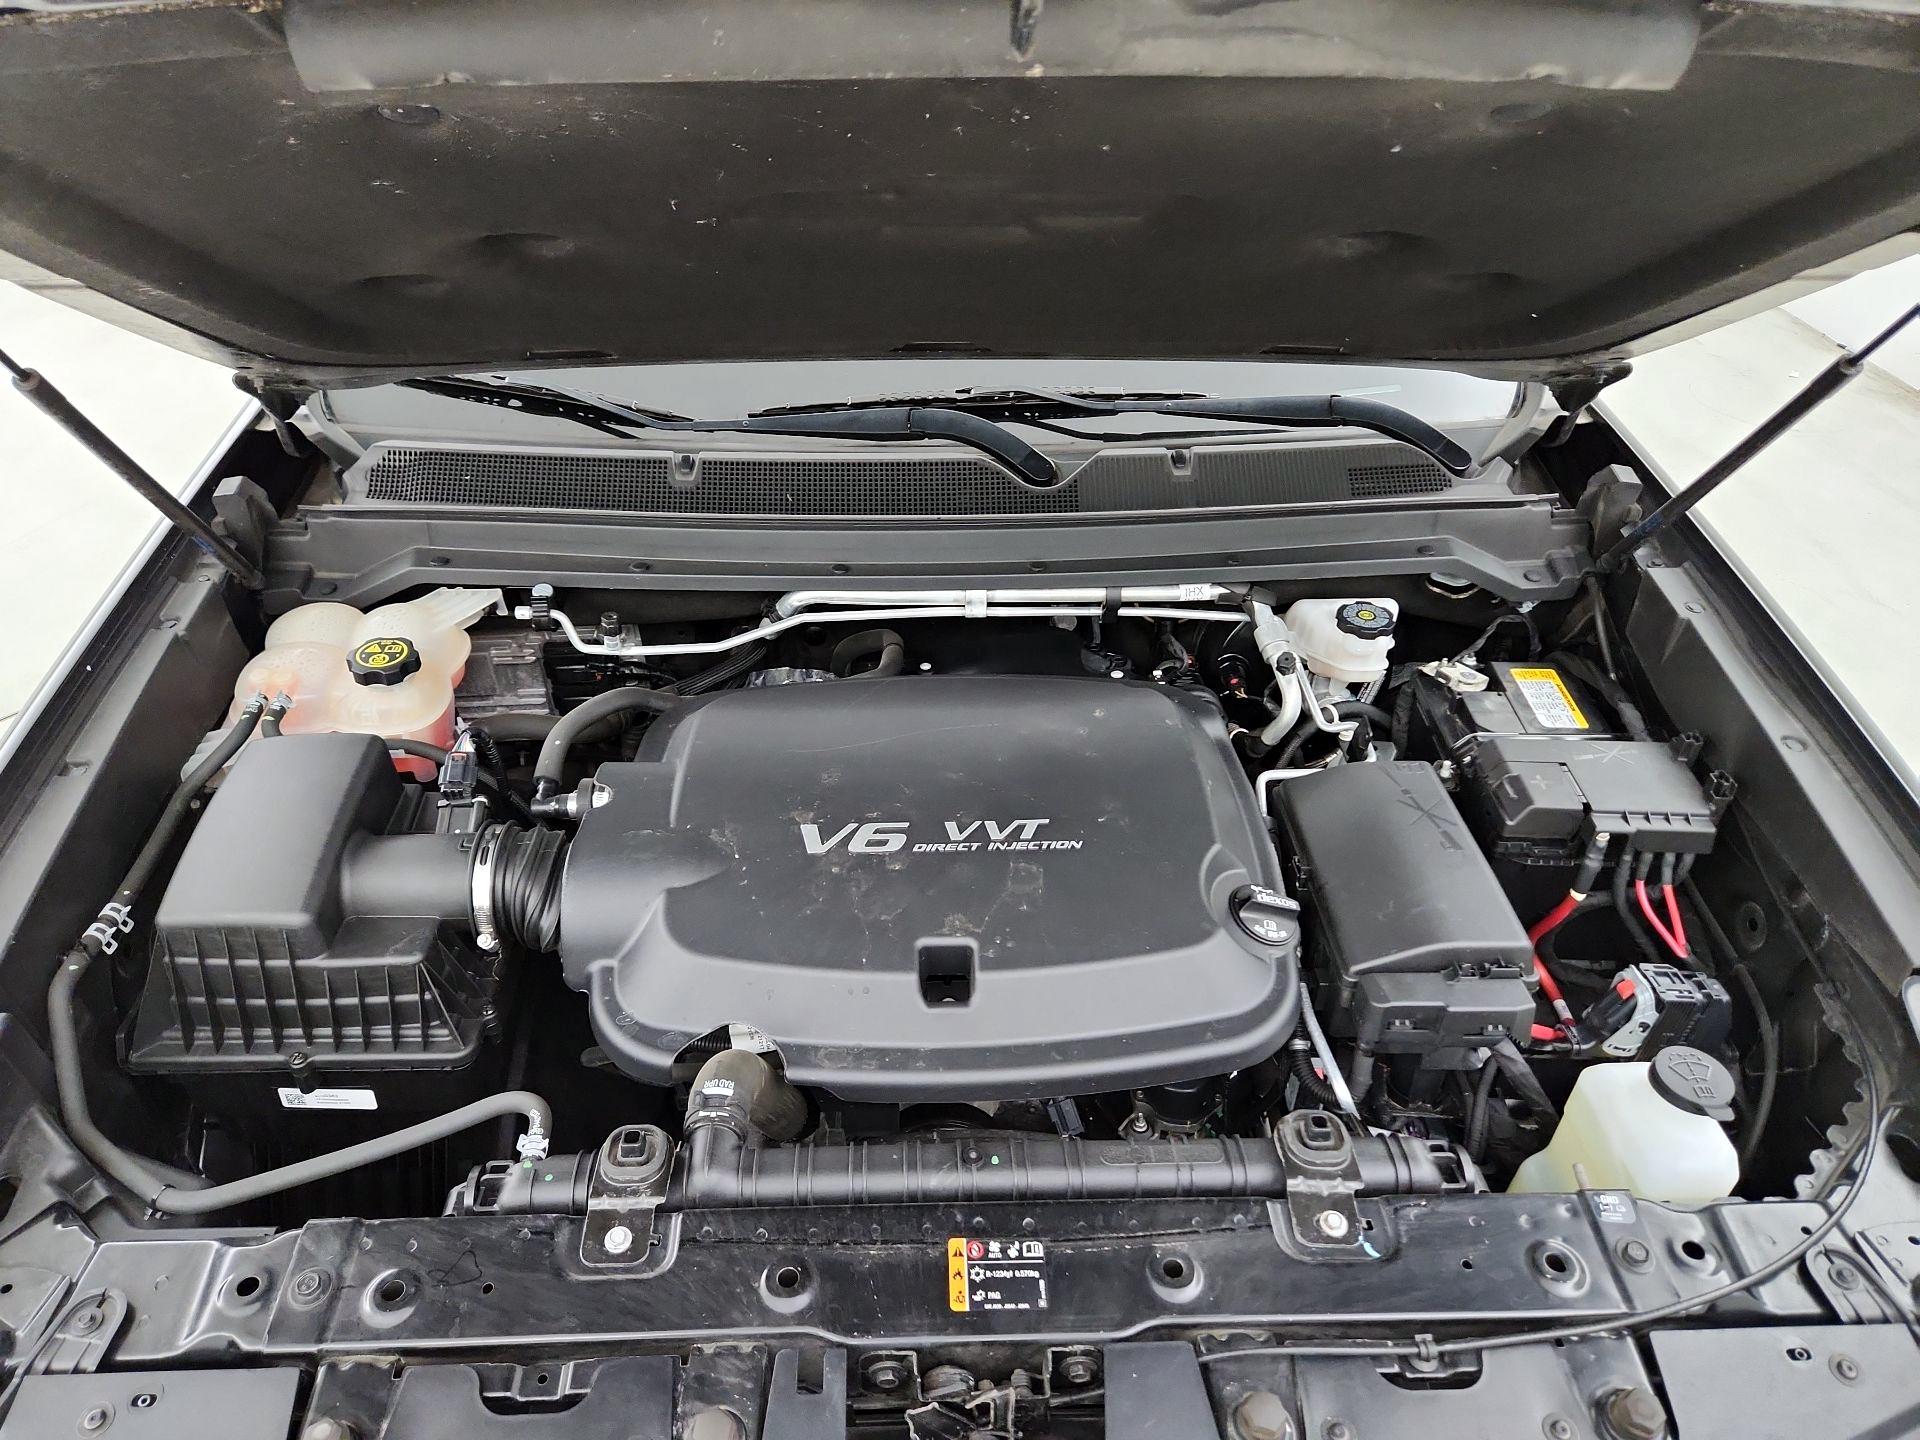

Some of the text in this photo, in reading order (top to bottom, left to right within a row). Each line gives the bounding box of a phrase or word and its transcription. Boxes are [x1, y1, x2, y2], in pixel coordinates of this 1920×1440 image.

[800, 822, 910, 854] V6
[944, 819, 1050, 841] VVT
[912, 840, 1083, 852] DIRECT INJECTION
[704, 1078, 735, 1089] RAD UPR
